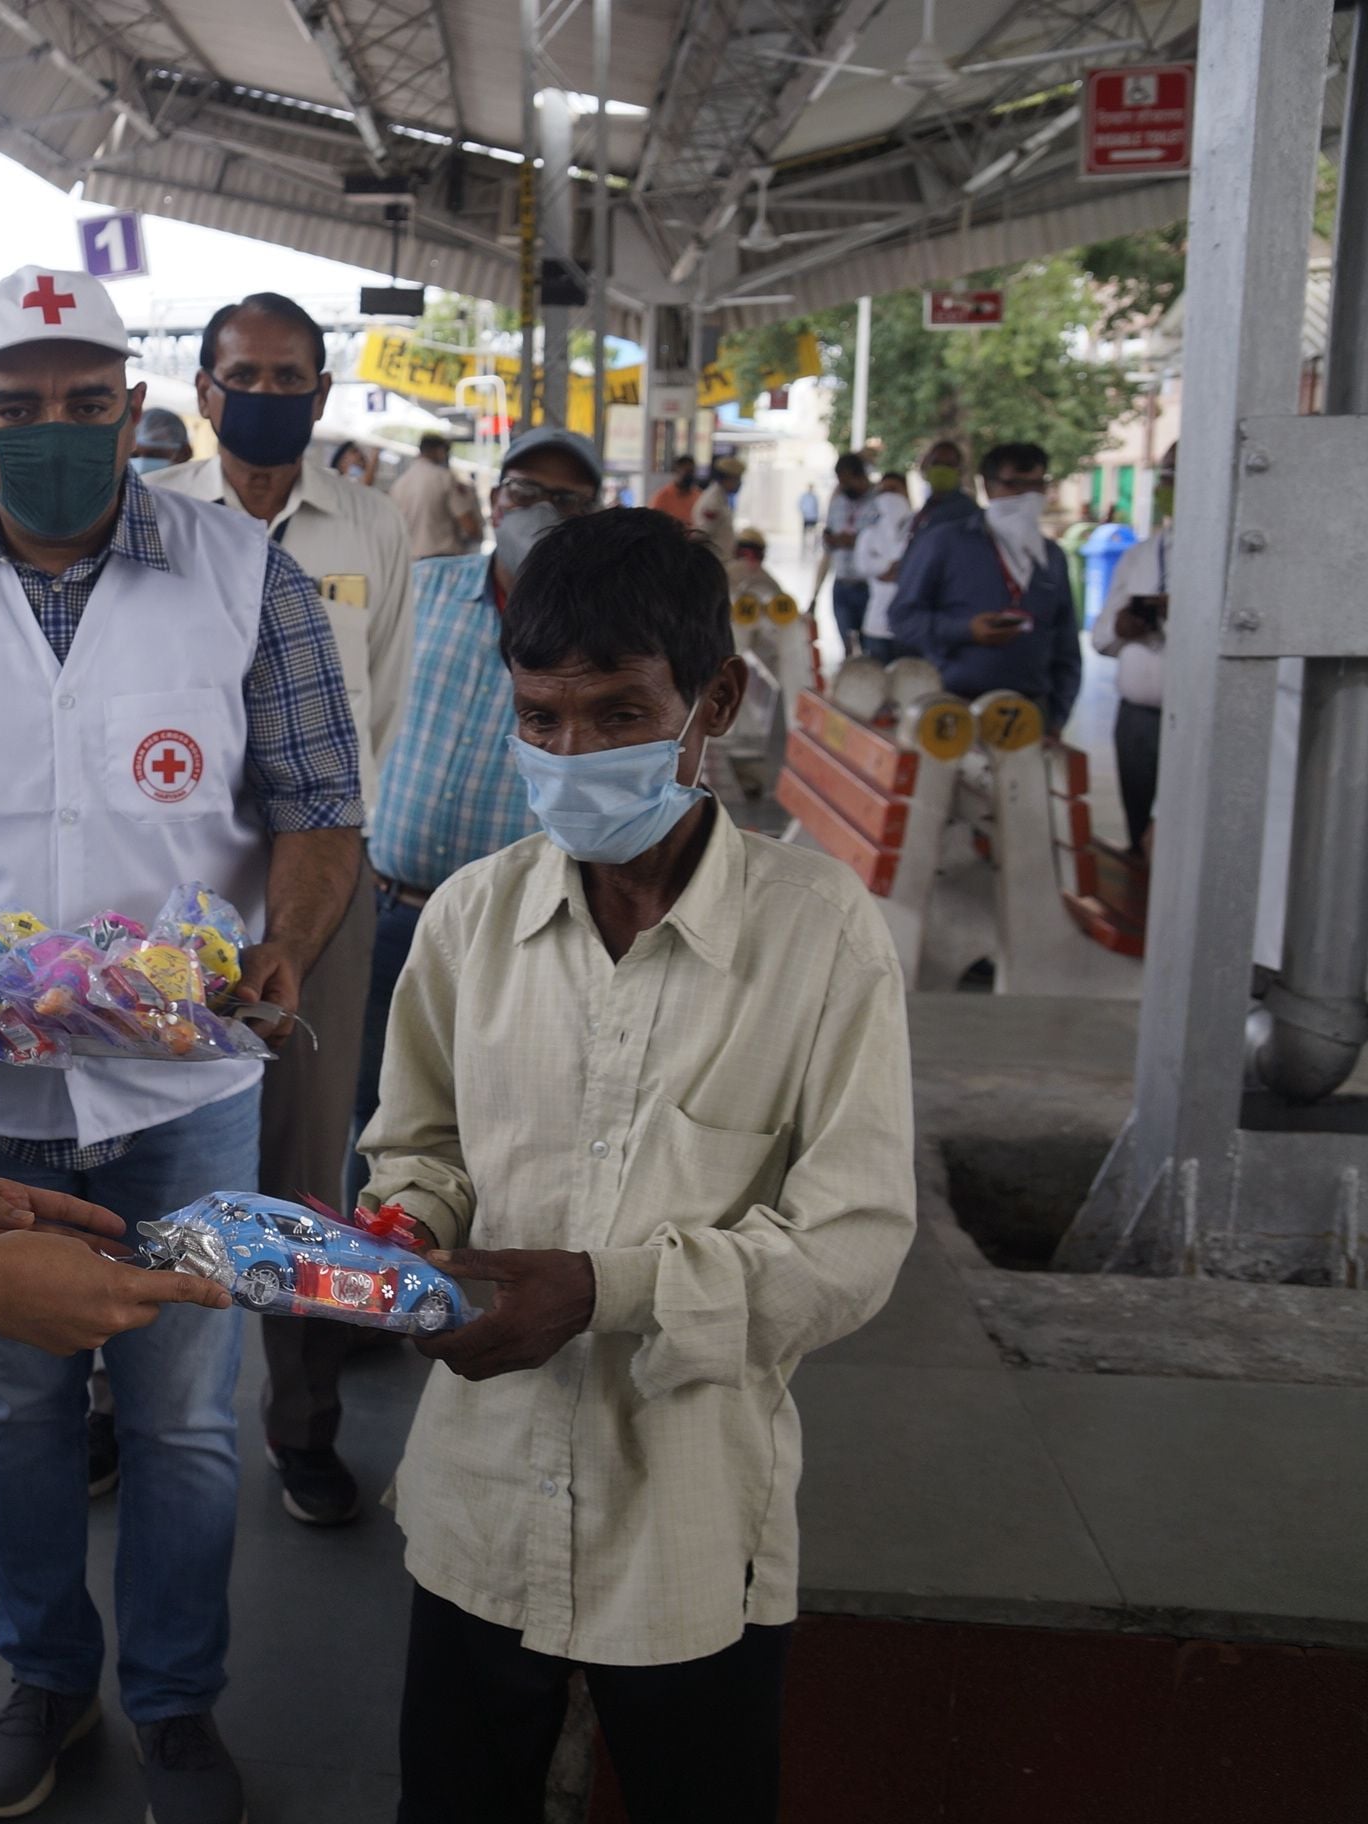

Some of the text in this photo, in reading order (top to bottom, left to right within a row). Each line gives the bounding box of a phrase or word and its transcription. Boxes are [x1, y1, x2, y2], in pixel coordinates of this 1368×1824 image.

[94, 218, 128, 272] 1
[998, 706, 1021, 738] 7
[135, 732, 202, 780] INDIAN RED CROSS SOCIETY
